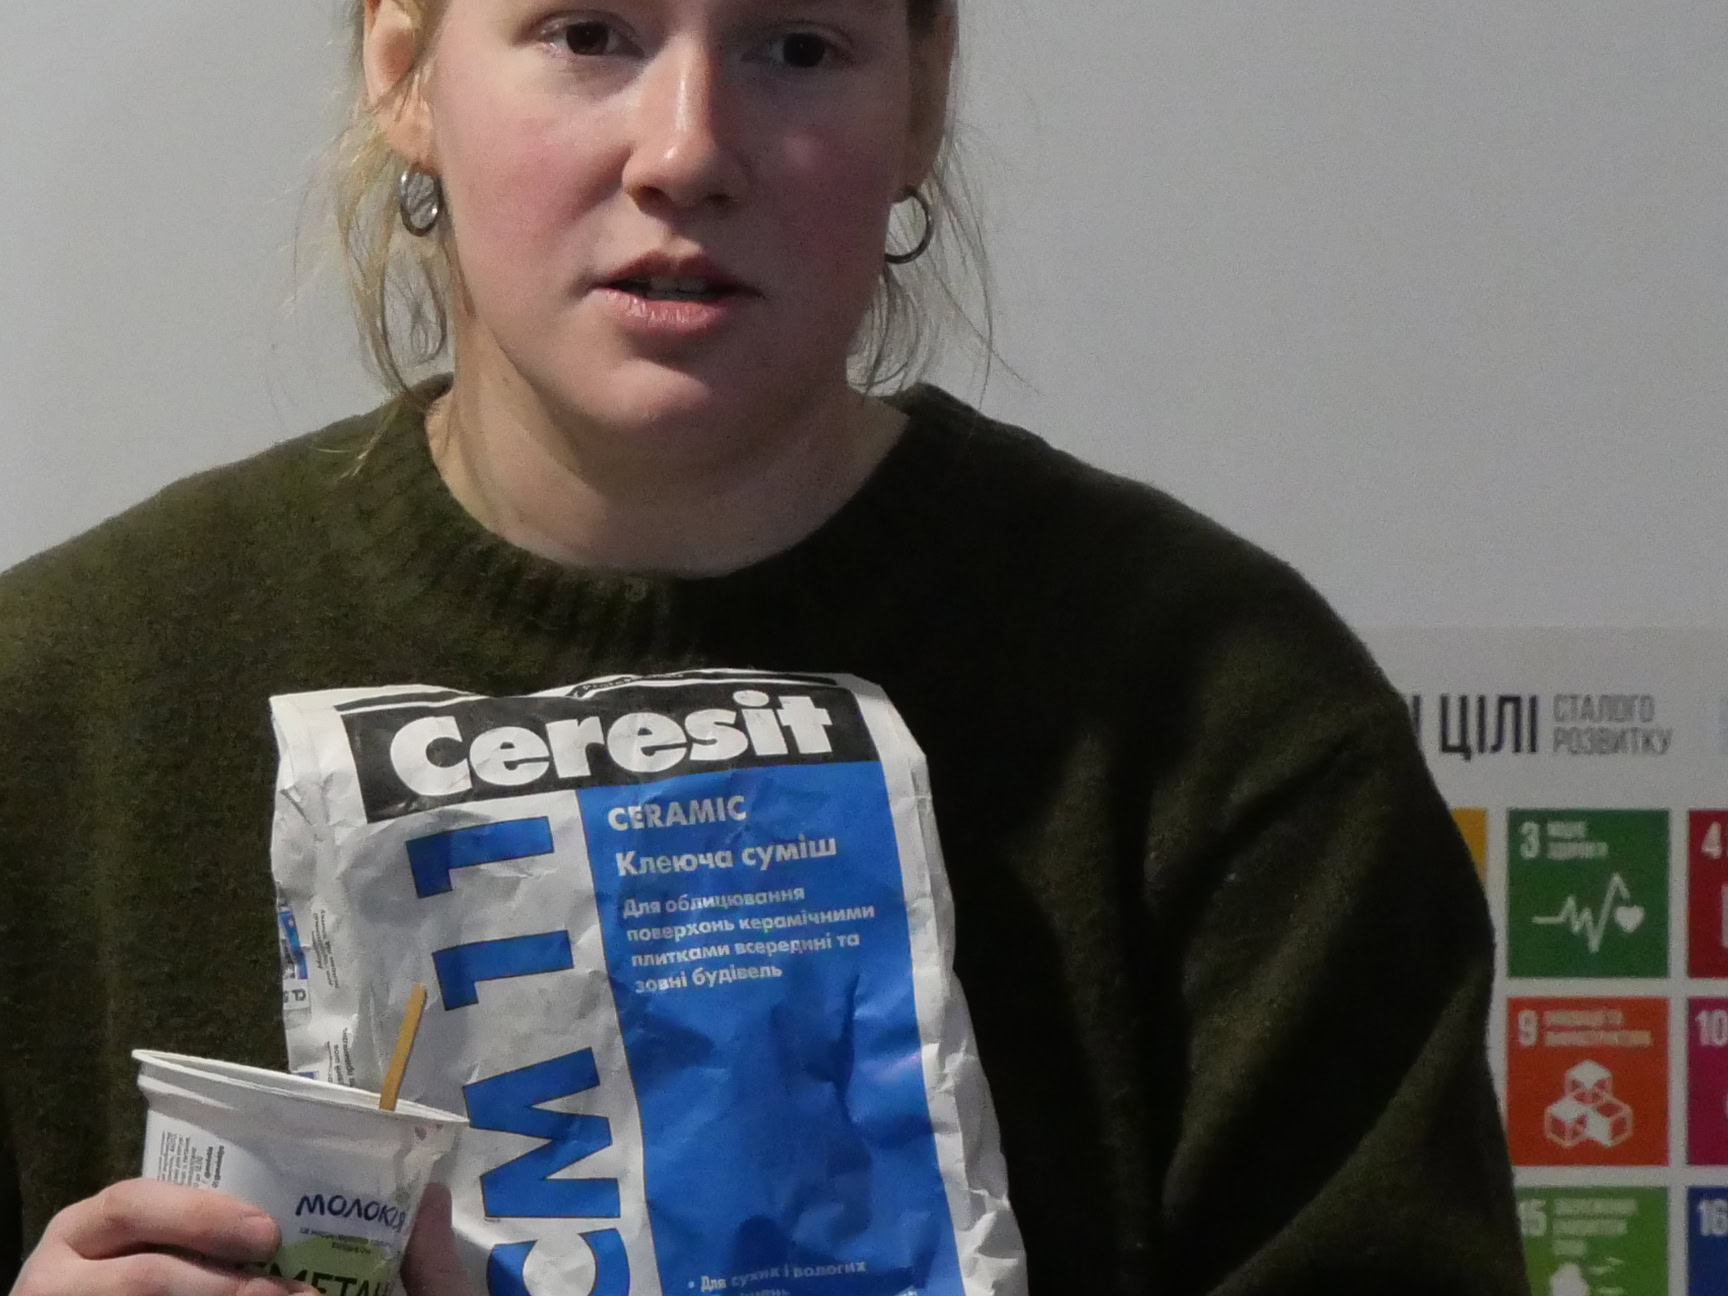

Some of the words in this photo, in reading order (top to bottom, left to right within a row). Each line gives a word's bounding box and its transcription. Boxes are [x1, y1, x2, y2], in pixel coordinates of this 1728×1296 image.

[1551, 692, 1655, 724] СТАЛОГО
[388, 690, 833, 797] Ceresit
[1439, 694, 1538, 763] ЦІЛІ
[1551, 725, 1673, 755] РОЗВИТКУ
[607, 794, 748, 832] CERAMIC
[615, 849, 734, 877] Клеюча
[741, 833, 838, 872] суміш
[1519, 820, 1541, 860] 3
[1700, 820, 1722, 860] 4
[623, 898, 662, 920] Для
[665, 886, 806, 913] облицювання
[626, 919, 735, 943] поверхонь
[738, 904, 876, 935] керамічними
[631, 943, 732, 968] плитками
[734, 931, 833, 958] всередині
[836, 933, 861, 948] та
[634, 970, 689, 994] зовні
[691, 963, 784, 988] будівель
[1516, 1008, 1539, 1047] 9
[700, 1274, 728, 1293] Для
[793, 1261, 867, 1278] вологих
